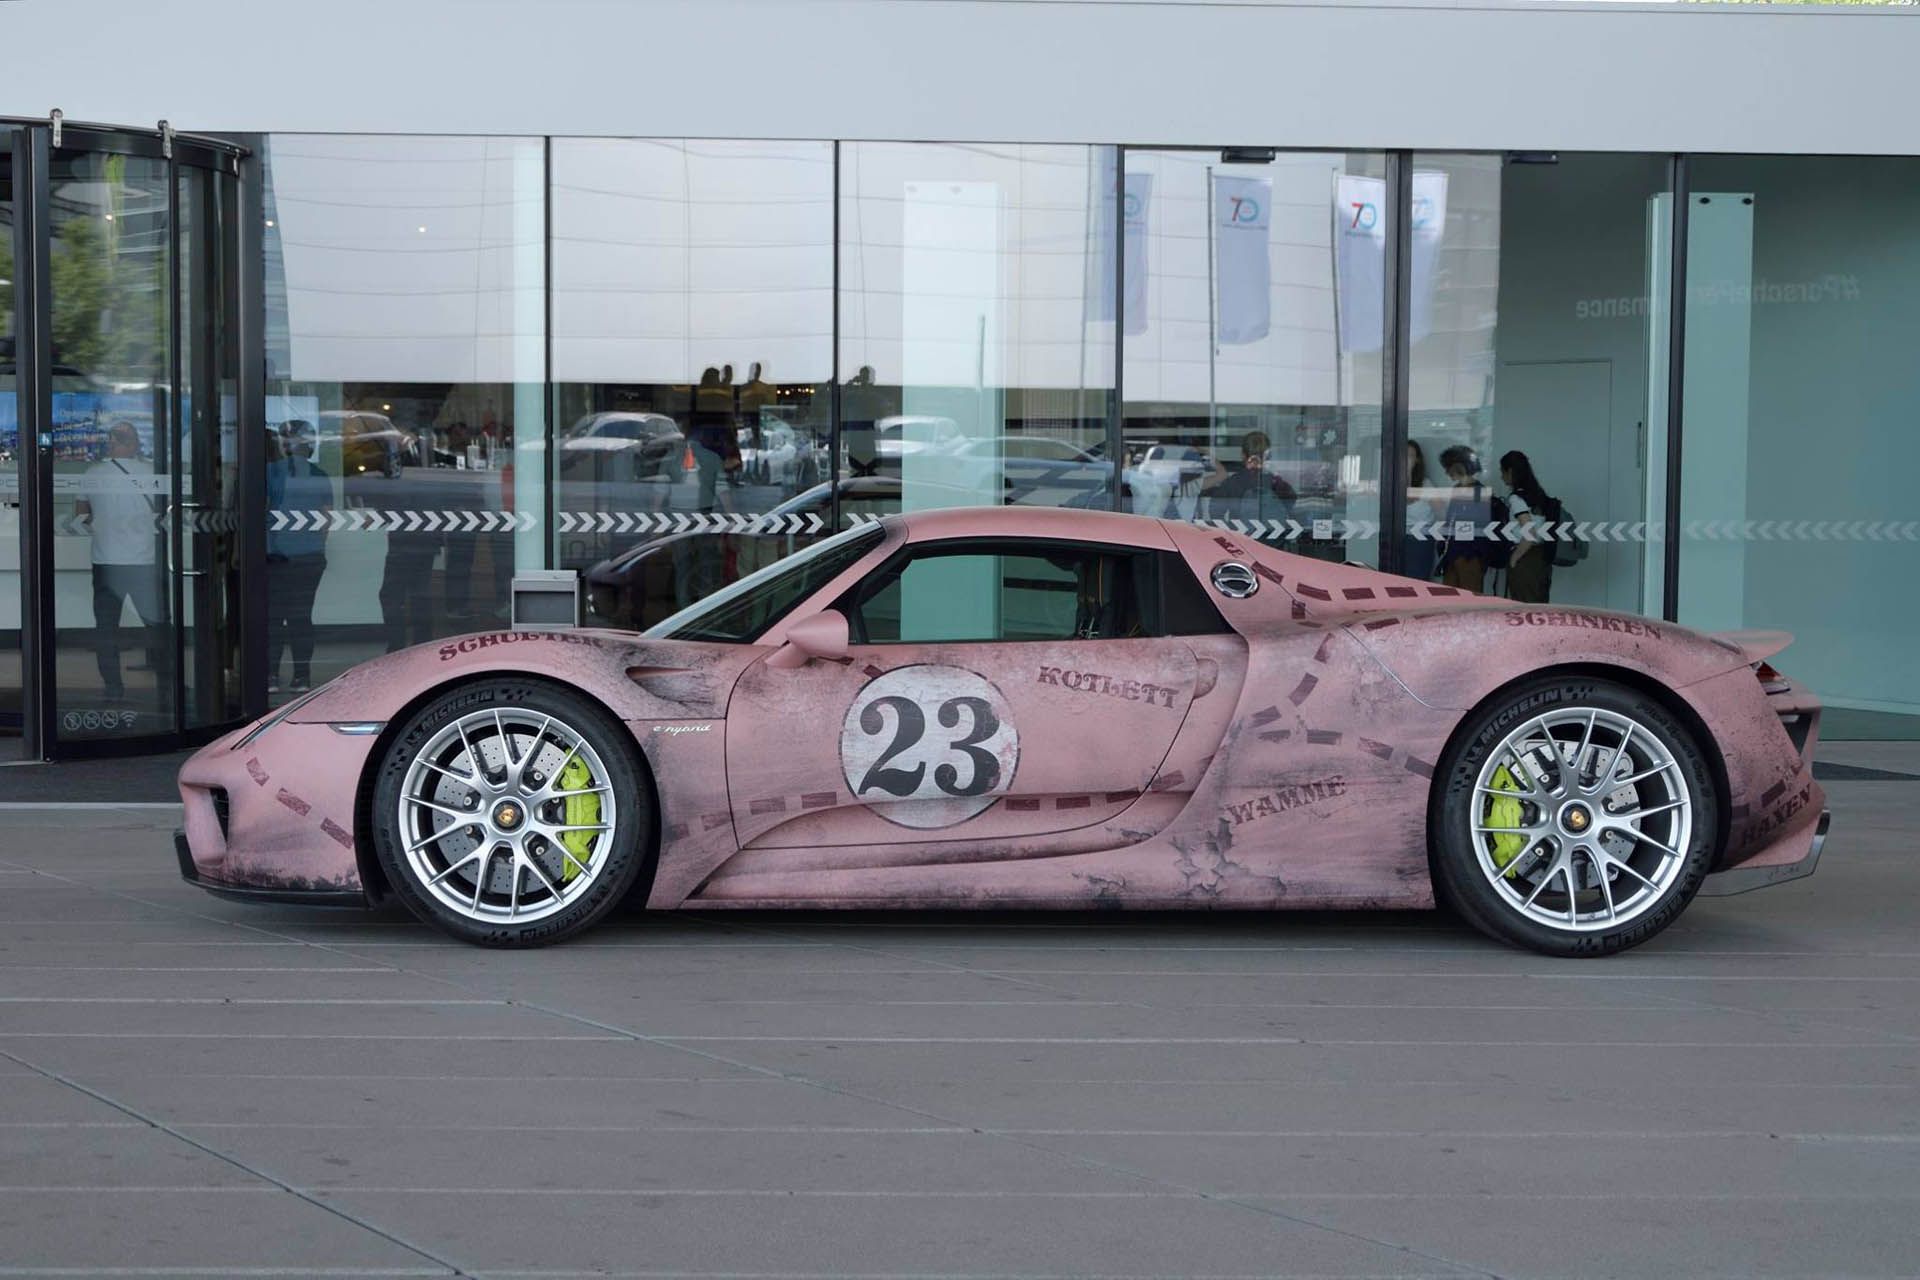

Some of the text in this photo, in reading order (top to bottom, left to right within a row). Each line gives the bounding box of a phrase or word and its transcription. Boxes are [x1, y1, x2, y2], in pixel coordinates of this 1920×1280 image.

[1504, 611, 1662, 640] SCHINKEN
[420, 688, 495, 730] MICHELIN
[1037, 666, 1180, 709] KOTLETT
[1480, 688, 1560, 743] MICHELIN
[857, 696, 1001, 797] 23
[1225, 775, 1347, 826] WAMME
